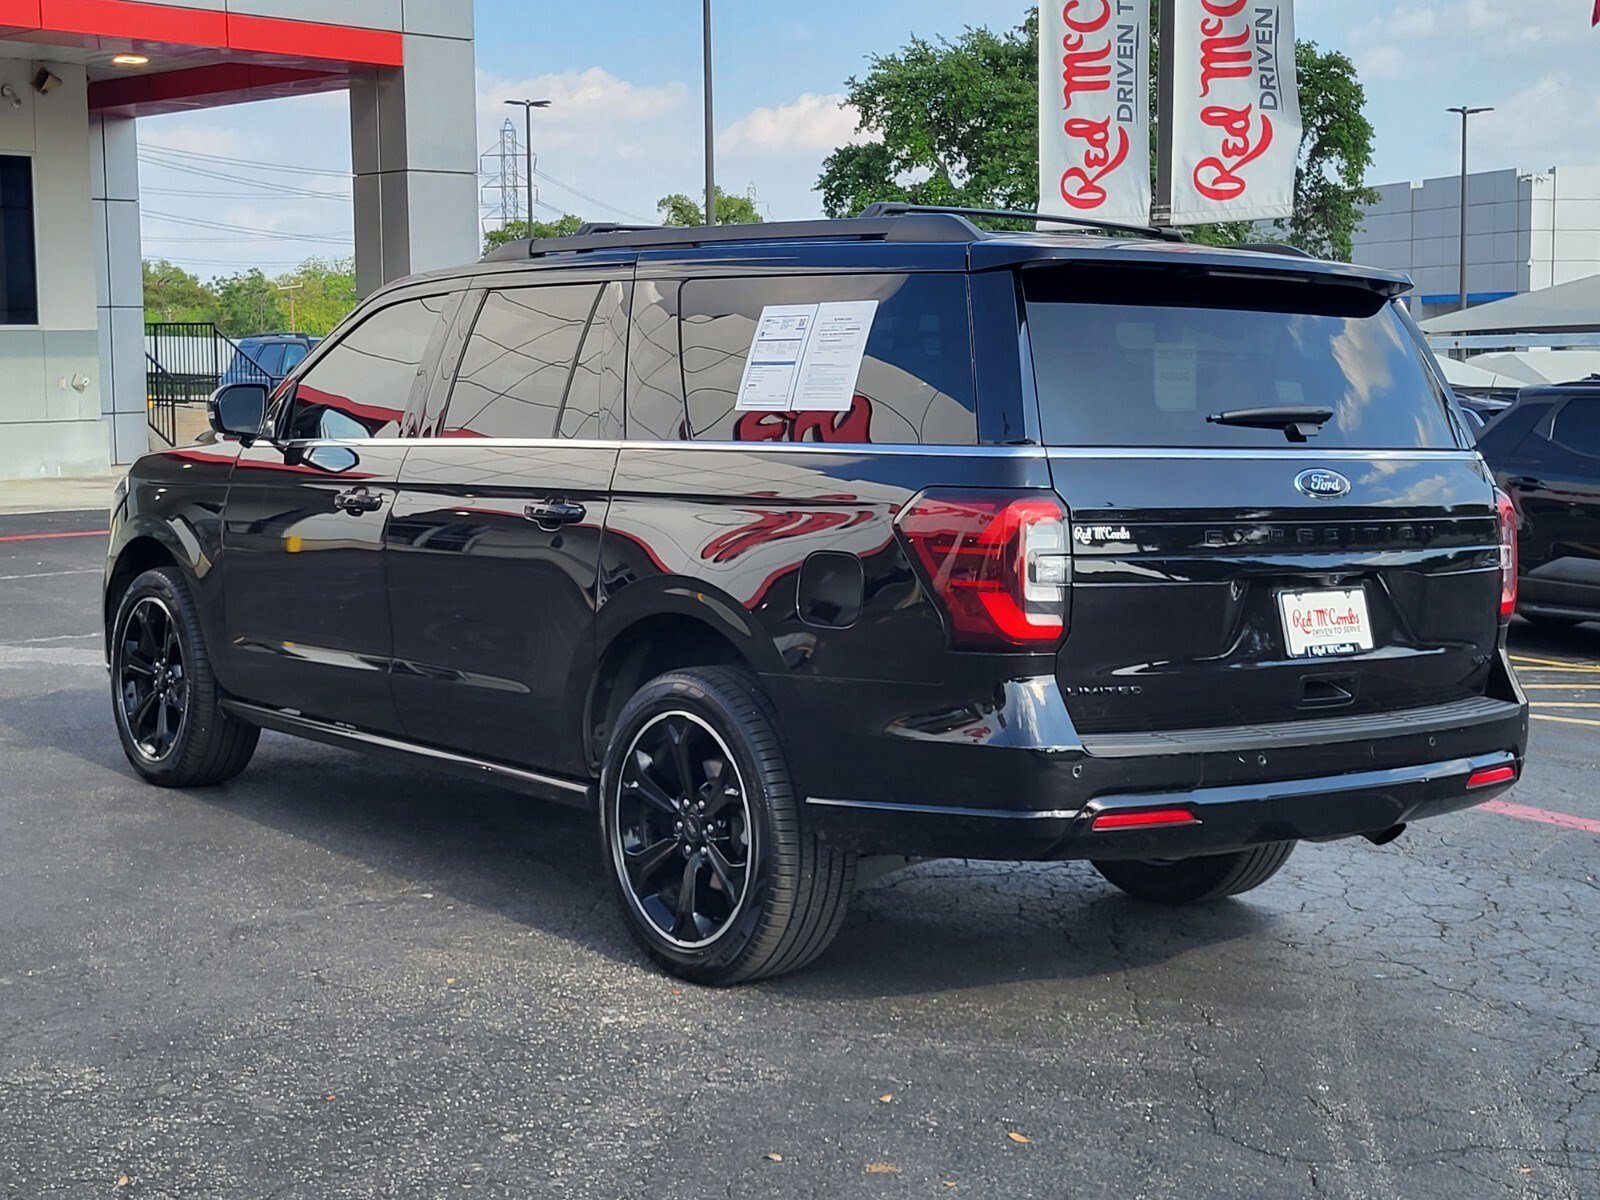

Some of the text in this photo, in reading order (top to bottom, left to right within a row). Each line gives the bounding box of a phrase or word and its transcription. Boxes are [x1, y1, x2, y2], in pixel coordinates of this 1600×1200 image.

[1254, 7, 1278, 110] DRIVEN
[1116, 24, 1134, 123] DRIVEN
[1060, 116, 1129, 209] Red
[1193, 103, 1273, 200] Red
[1310, 474, 1340, 491] Ford
[1074, 526, 1130, 545] Red McCombs
[1204, 525, 1435, 545] EXPEDITION
[1293, 607, 1360, 634] Red McCombs
[1312, 625, 1361, 636] DRIVEN TO SERVE
[1066, 686, 1143, 697] LIMITED
